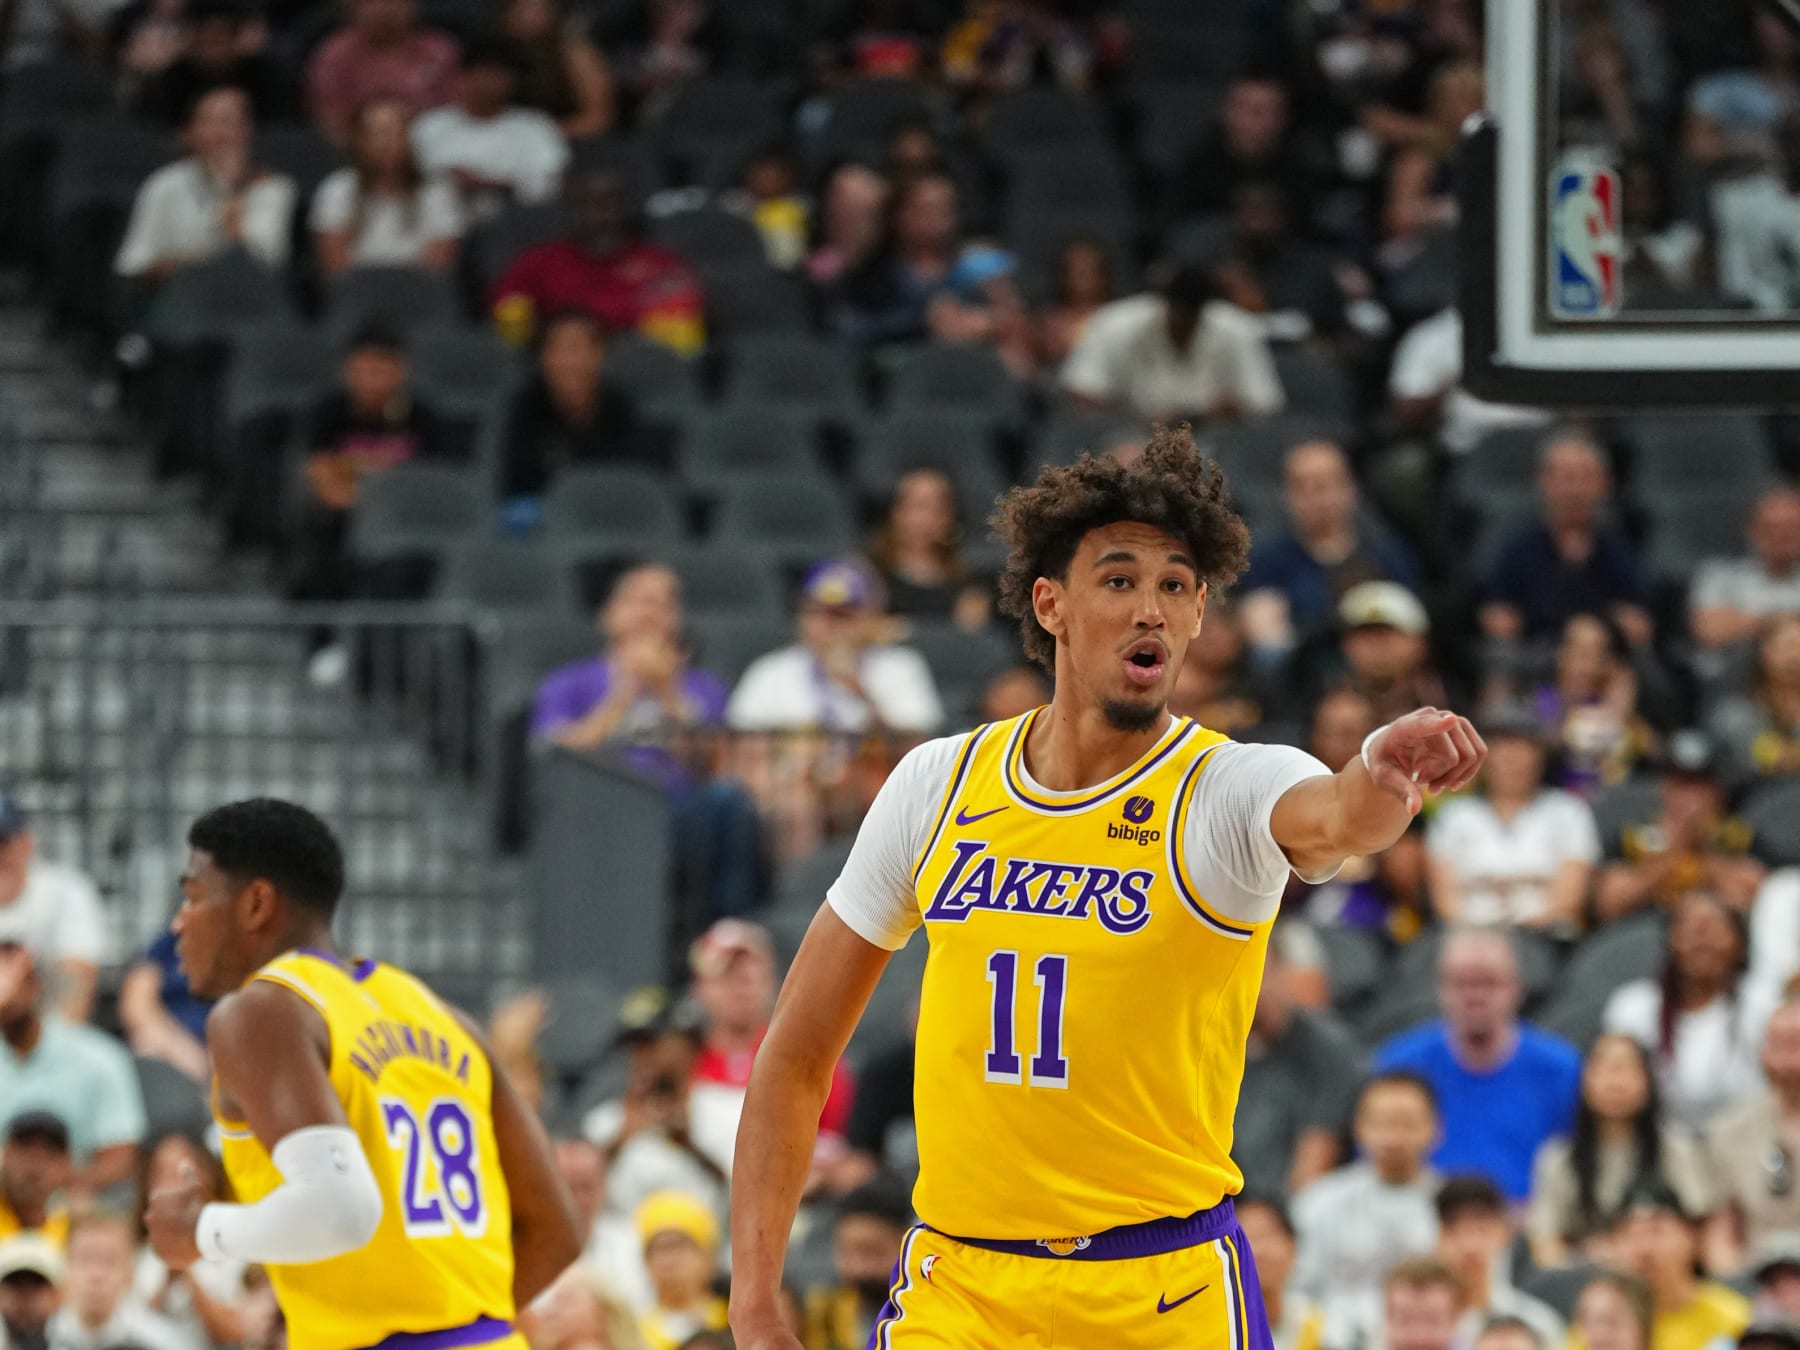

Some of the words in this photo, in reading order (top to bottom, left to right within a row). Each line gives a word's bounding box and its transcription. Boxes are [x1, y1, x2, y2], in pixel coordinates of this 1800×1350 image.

[924, 840, 1156, 935] LAKERS
[1107, 823, 1160, 846] bibigo
[984, 949, 1068, 1090] 11
[378, 1097, 488, 1238] 28
